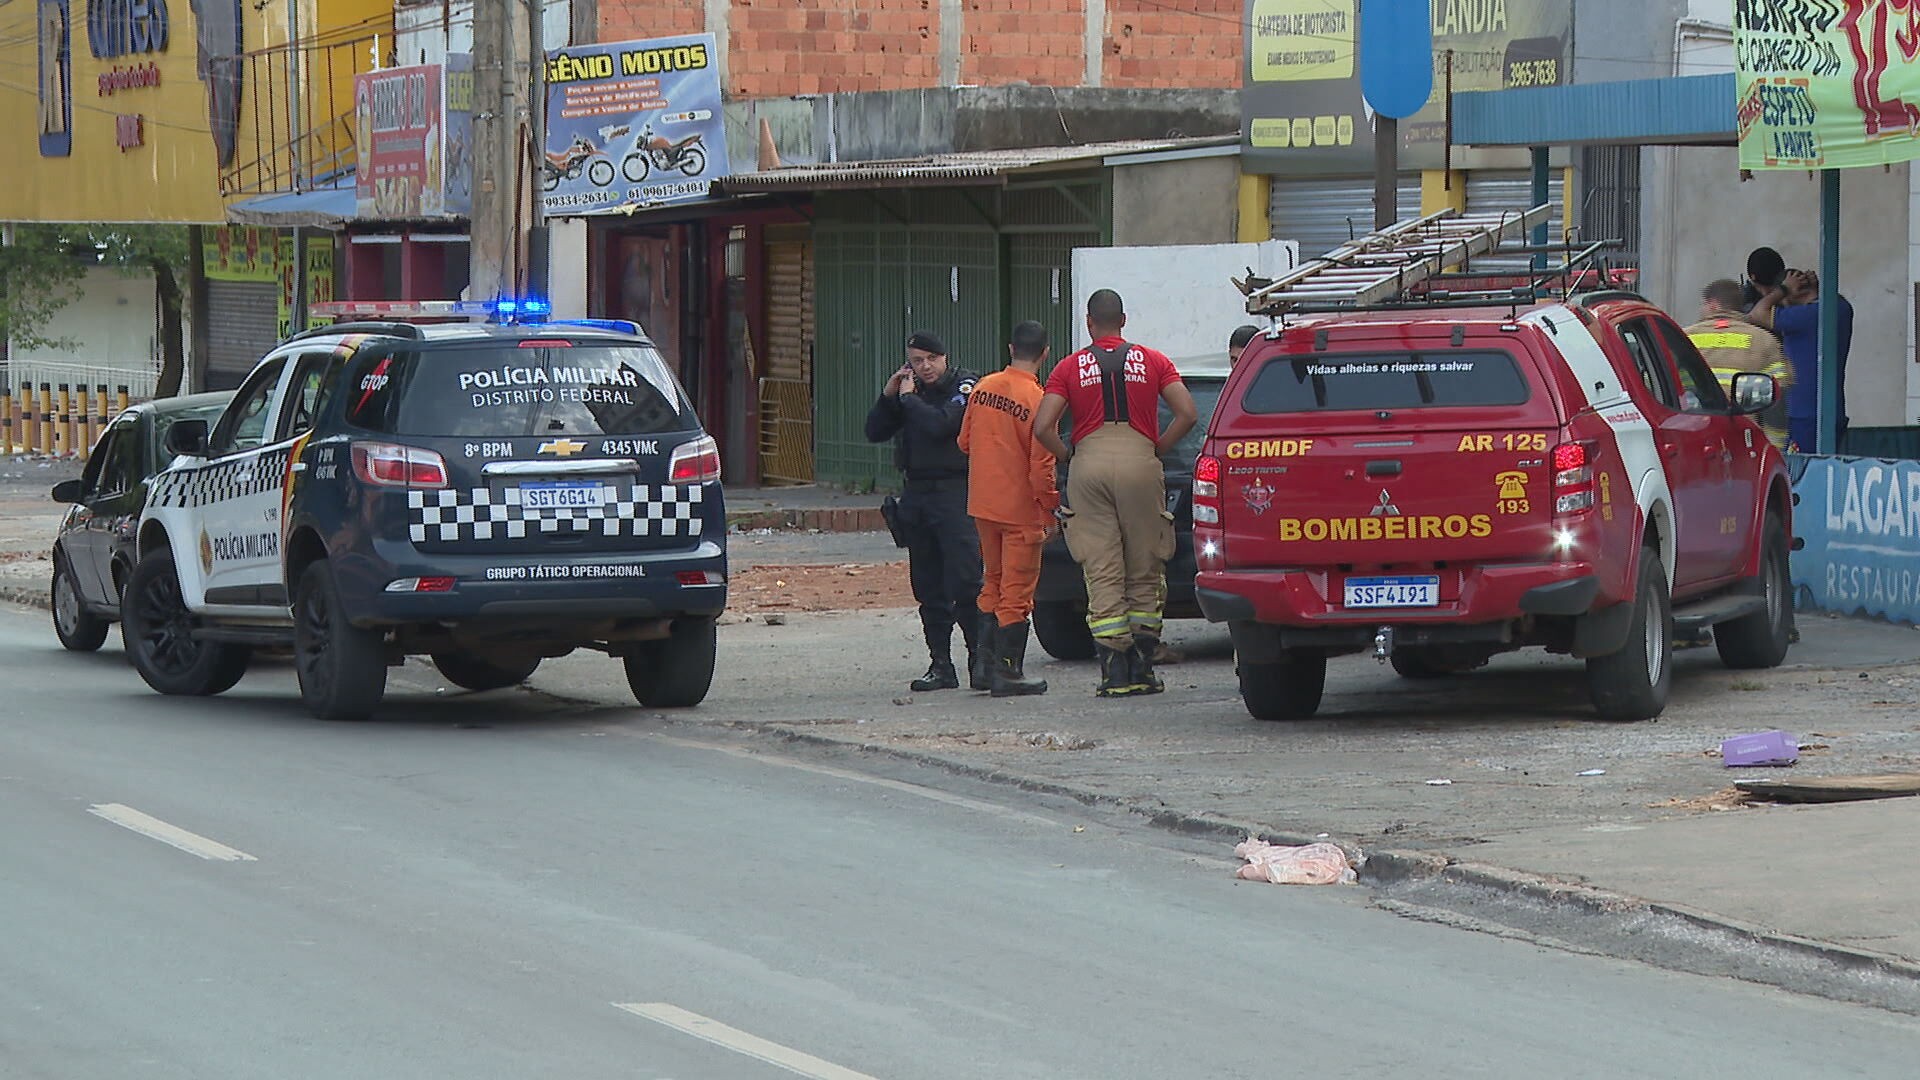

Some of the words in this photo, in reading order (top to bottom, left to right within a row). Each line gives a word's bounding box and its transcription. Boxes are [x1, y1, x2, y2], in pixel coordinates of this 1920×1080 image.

[1257, 13, 1292, 37] CARTEIRA
[1294, 14, 1302, 36] DE
[1304, 11, 1346, 35] MOTORISTA
[622, 45, 707, 76] MOTOS
[1509, 59, 1557, 87] 3965-7638
[1760, 84, 1815, 127] ESPETO
[459, 366, 554, 391] POLÍCIA
[553, 366, 639, 389] MILITAR
[1306, 362, 1338, 376] Vidas
[1340, 362, 1379, 375] alheias
[1391, 361, 1438, 375] riquezas
[1440, 361, 1474, 373] salvar
[360, 373, 390, 392] GTOP
[471, 388, 555, 408] DISTRITO
[560, 388, 635, 406] FEDERAL
[482, 443, 513, 458] BPM
[601, 440, 632, 456] 4345
[633, 440, 659, 456] VMC
[1226, 440, 1313, 460] CBMDF
[1457, 435, 1494, 452] AR
[1503, 434, 1547, 452] 125
[1255, 466, 1288, 475] TRITON
[529, 486, 597, 507] SGT6G14
[1495, 500, 1530, 514] 193
[1279, 514, 1492, 542] BOMBEIROS
[214, 531, 246, 561] POLÍCIA
[247, 532, 278, 557] MILITAR
[486, 566, 526, 581] GRUPO
[528, 564, 570, 580] TÁTICO
[572, 564, 646, 579] OPERACIONAL
[1353, 585, 1429, 604] SSF4I91
